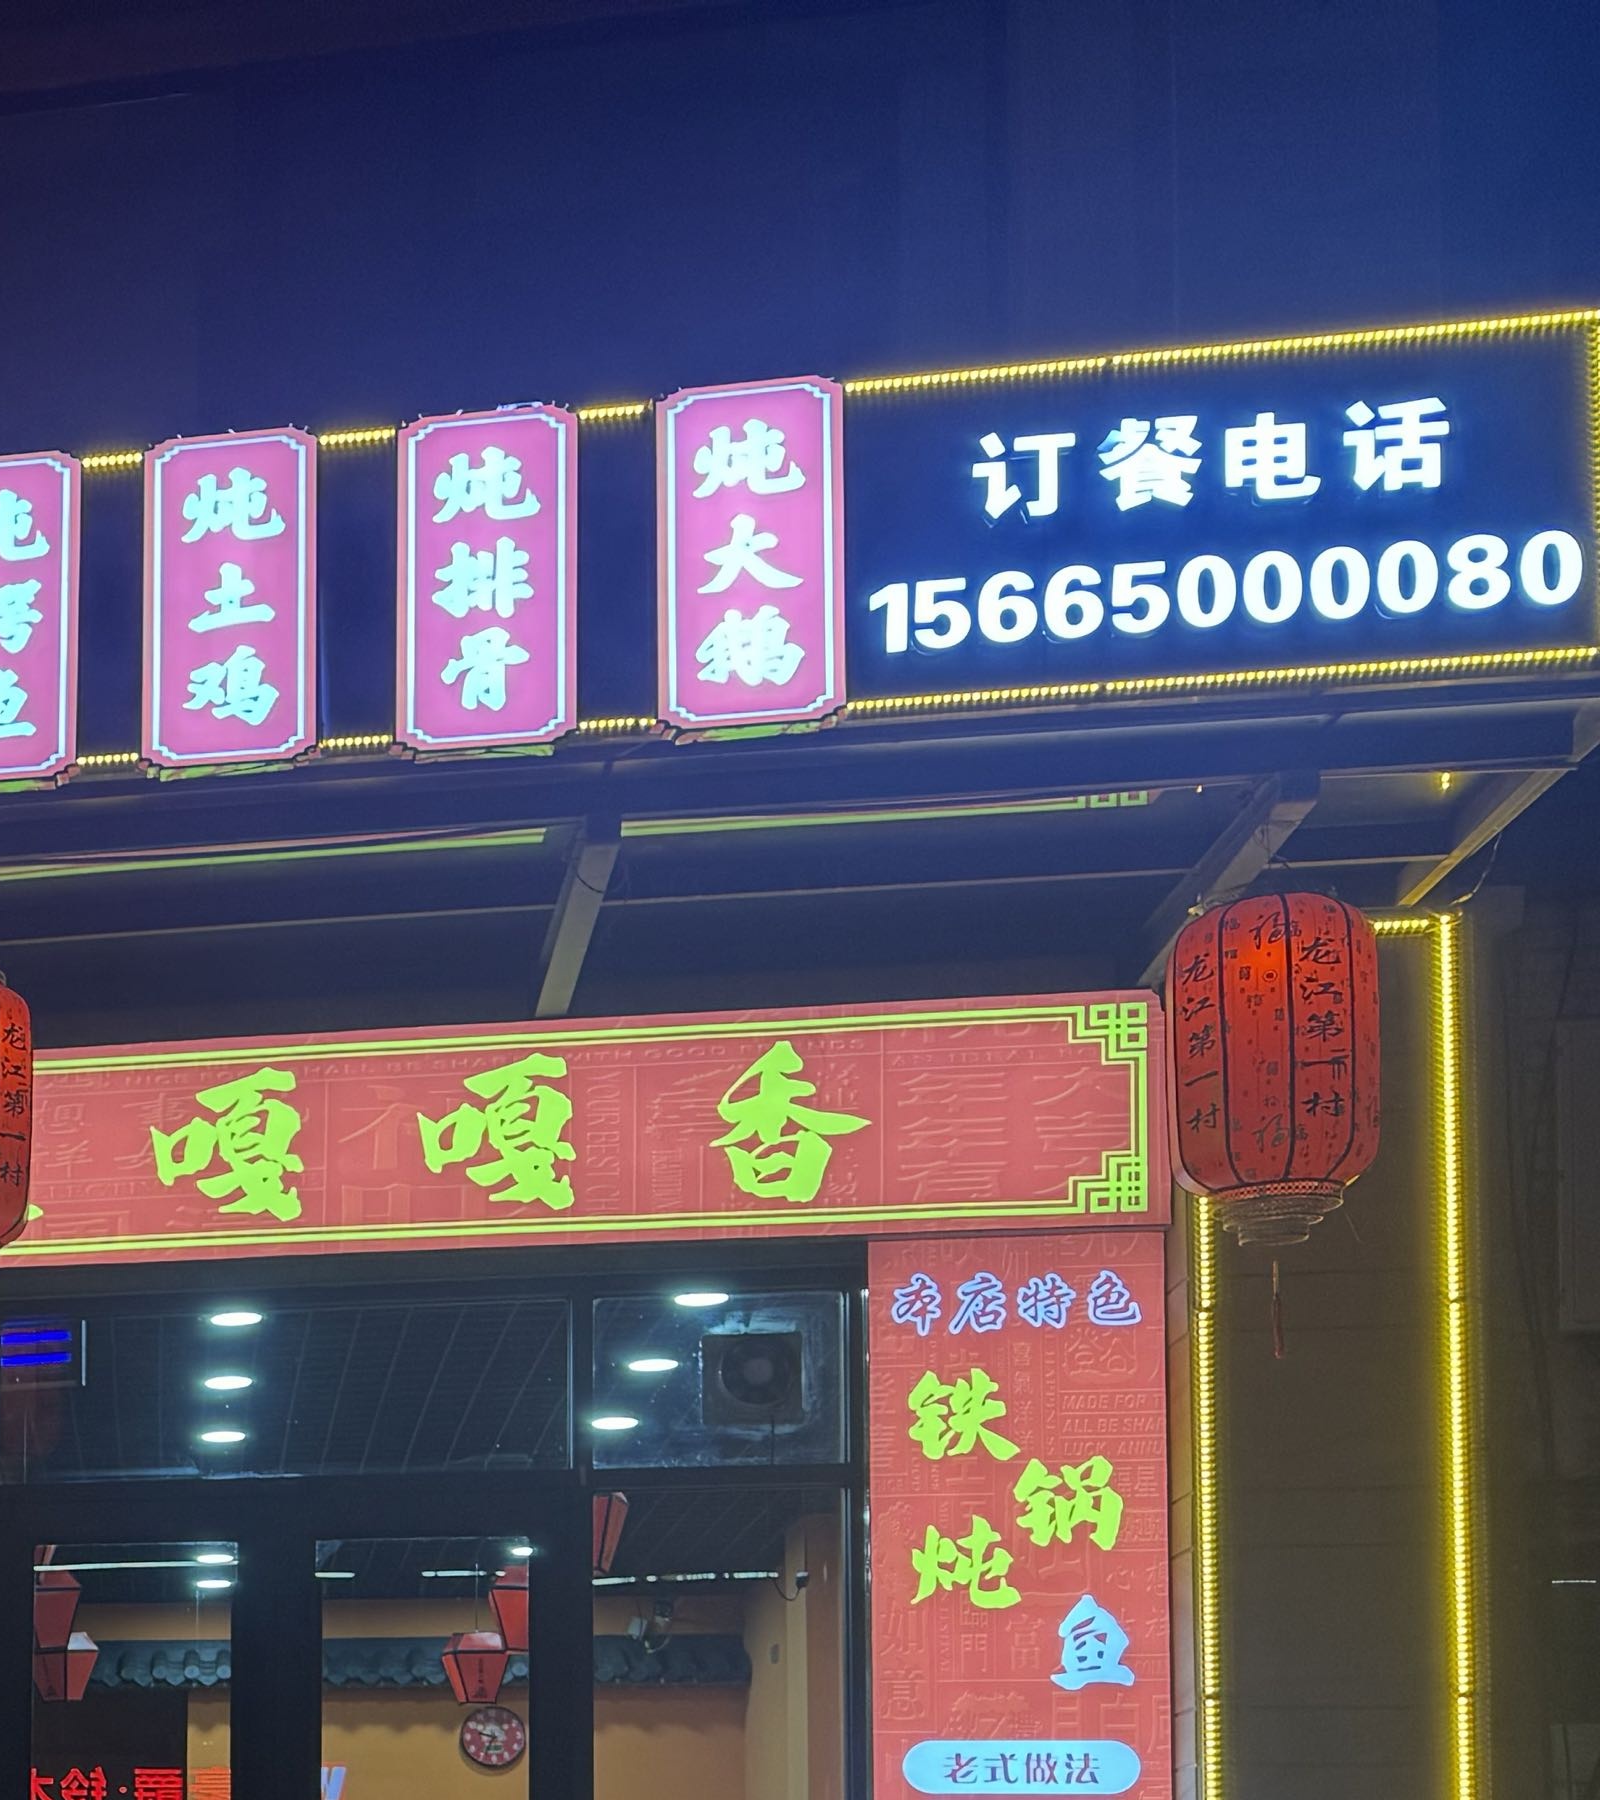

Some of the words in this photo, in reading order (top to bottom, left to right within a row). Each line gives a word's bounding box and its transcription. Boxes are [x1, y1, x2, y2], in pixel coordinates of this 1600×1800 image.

[972, 396, 1452, 522] 订餐电话
[180, 467, 286, 727] 炖土鸡
[431, 445, 541, 711] 炖排骨
[691, 418, 806, 689] 炖大鹅
[867, 527, 1585, 655] 15665000080
[0, 1022, 27, 1187] 龙江第一村
[1179, 954, 1220, 1134] 龙江第一村
[1299, 935, 1349, 1118] 龙江第一村
[891, 1269, 1142, 1337] 本店特色
[908, 1367, 1124, 1610] 铁锅炖
[1050, 1593, 1136, 1691] 鱼
[943, 1752, 1100, 1786] 老式做法
